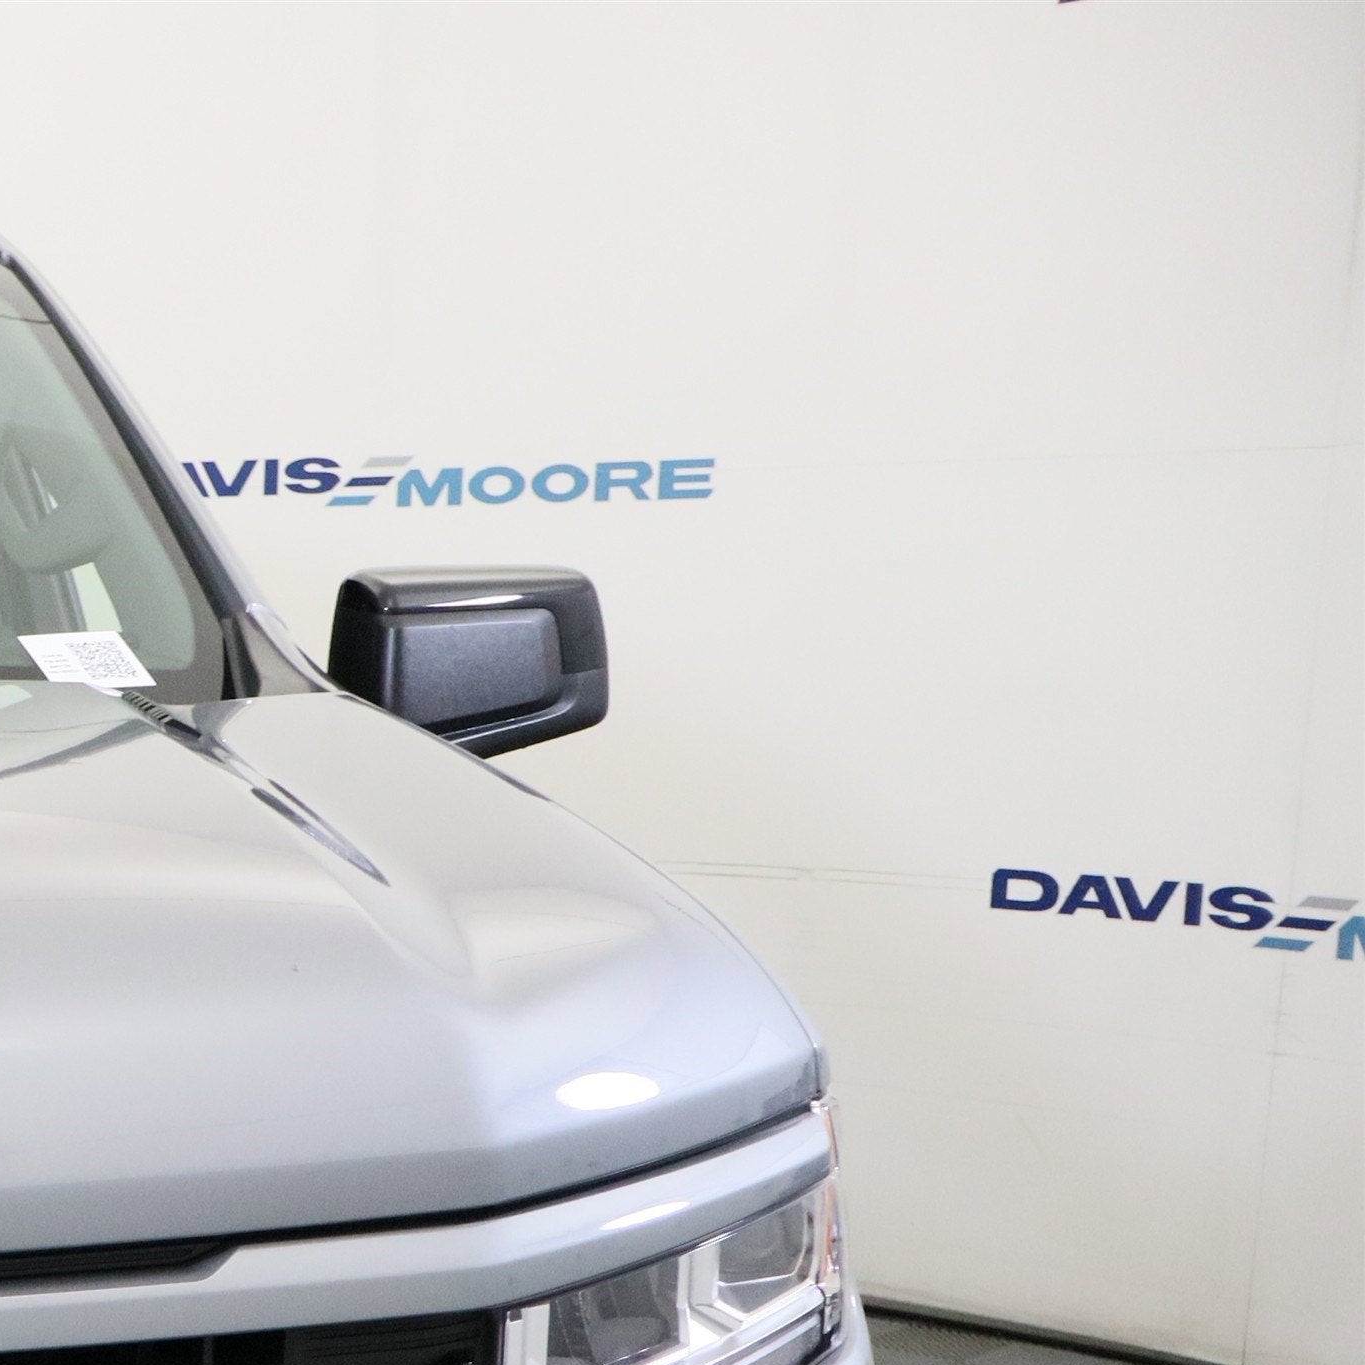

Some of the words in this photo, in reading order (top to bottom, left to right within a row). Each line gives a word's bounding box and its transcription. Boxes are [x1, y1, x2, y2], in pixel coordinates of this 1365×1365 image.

[182, 457, 342, 497] VIS
[396, 457, 716, 507] MOORE
[990, 868, 1275, 931] DAVIS
